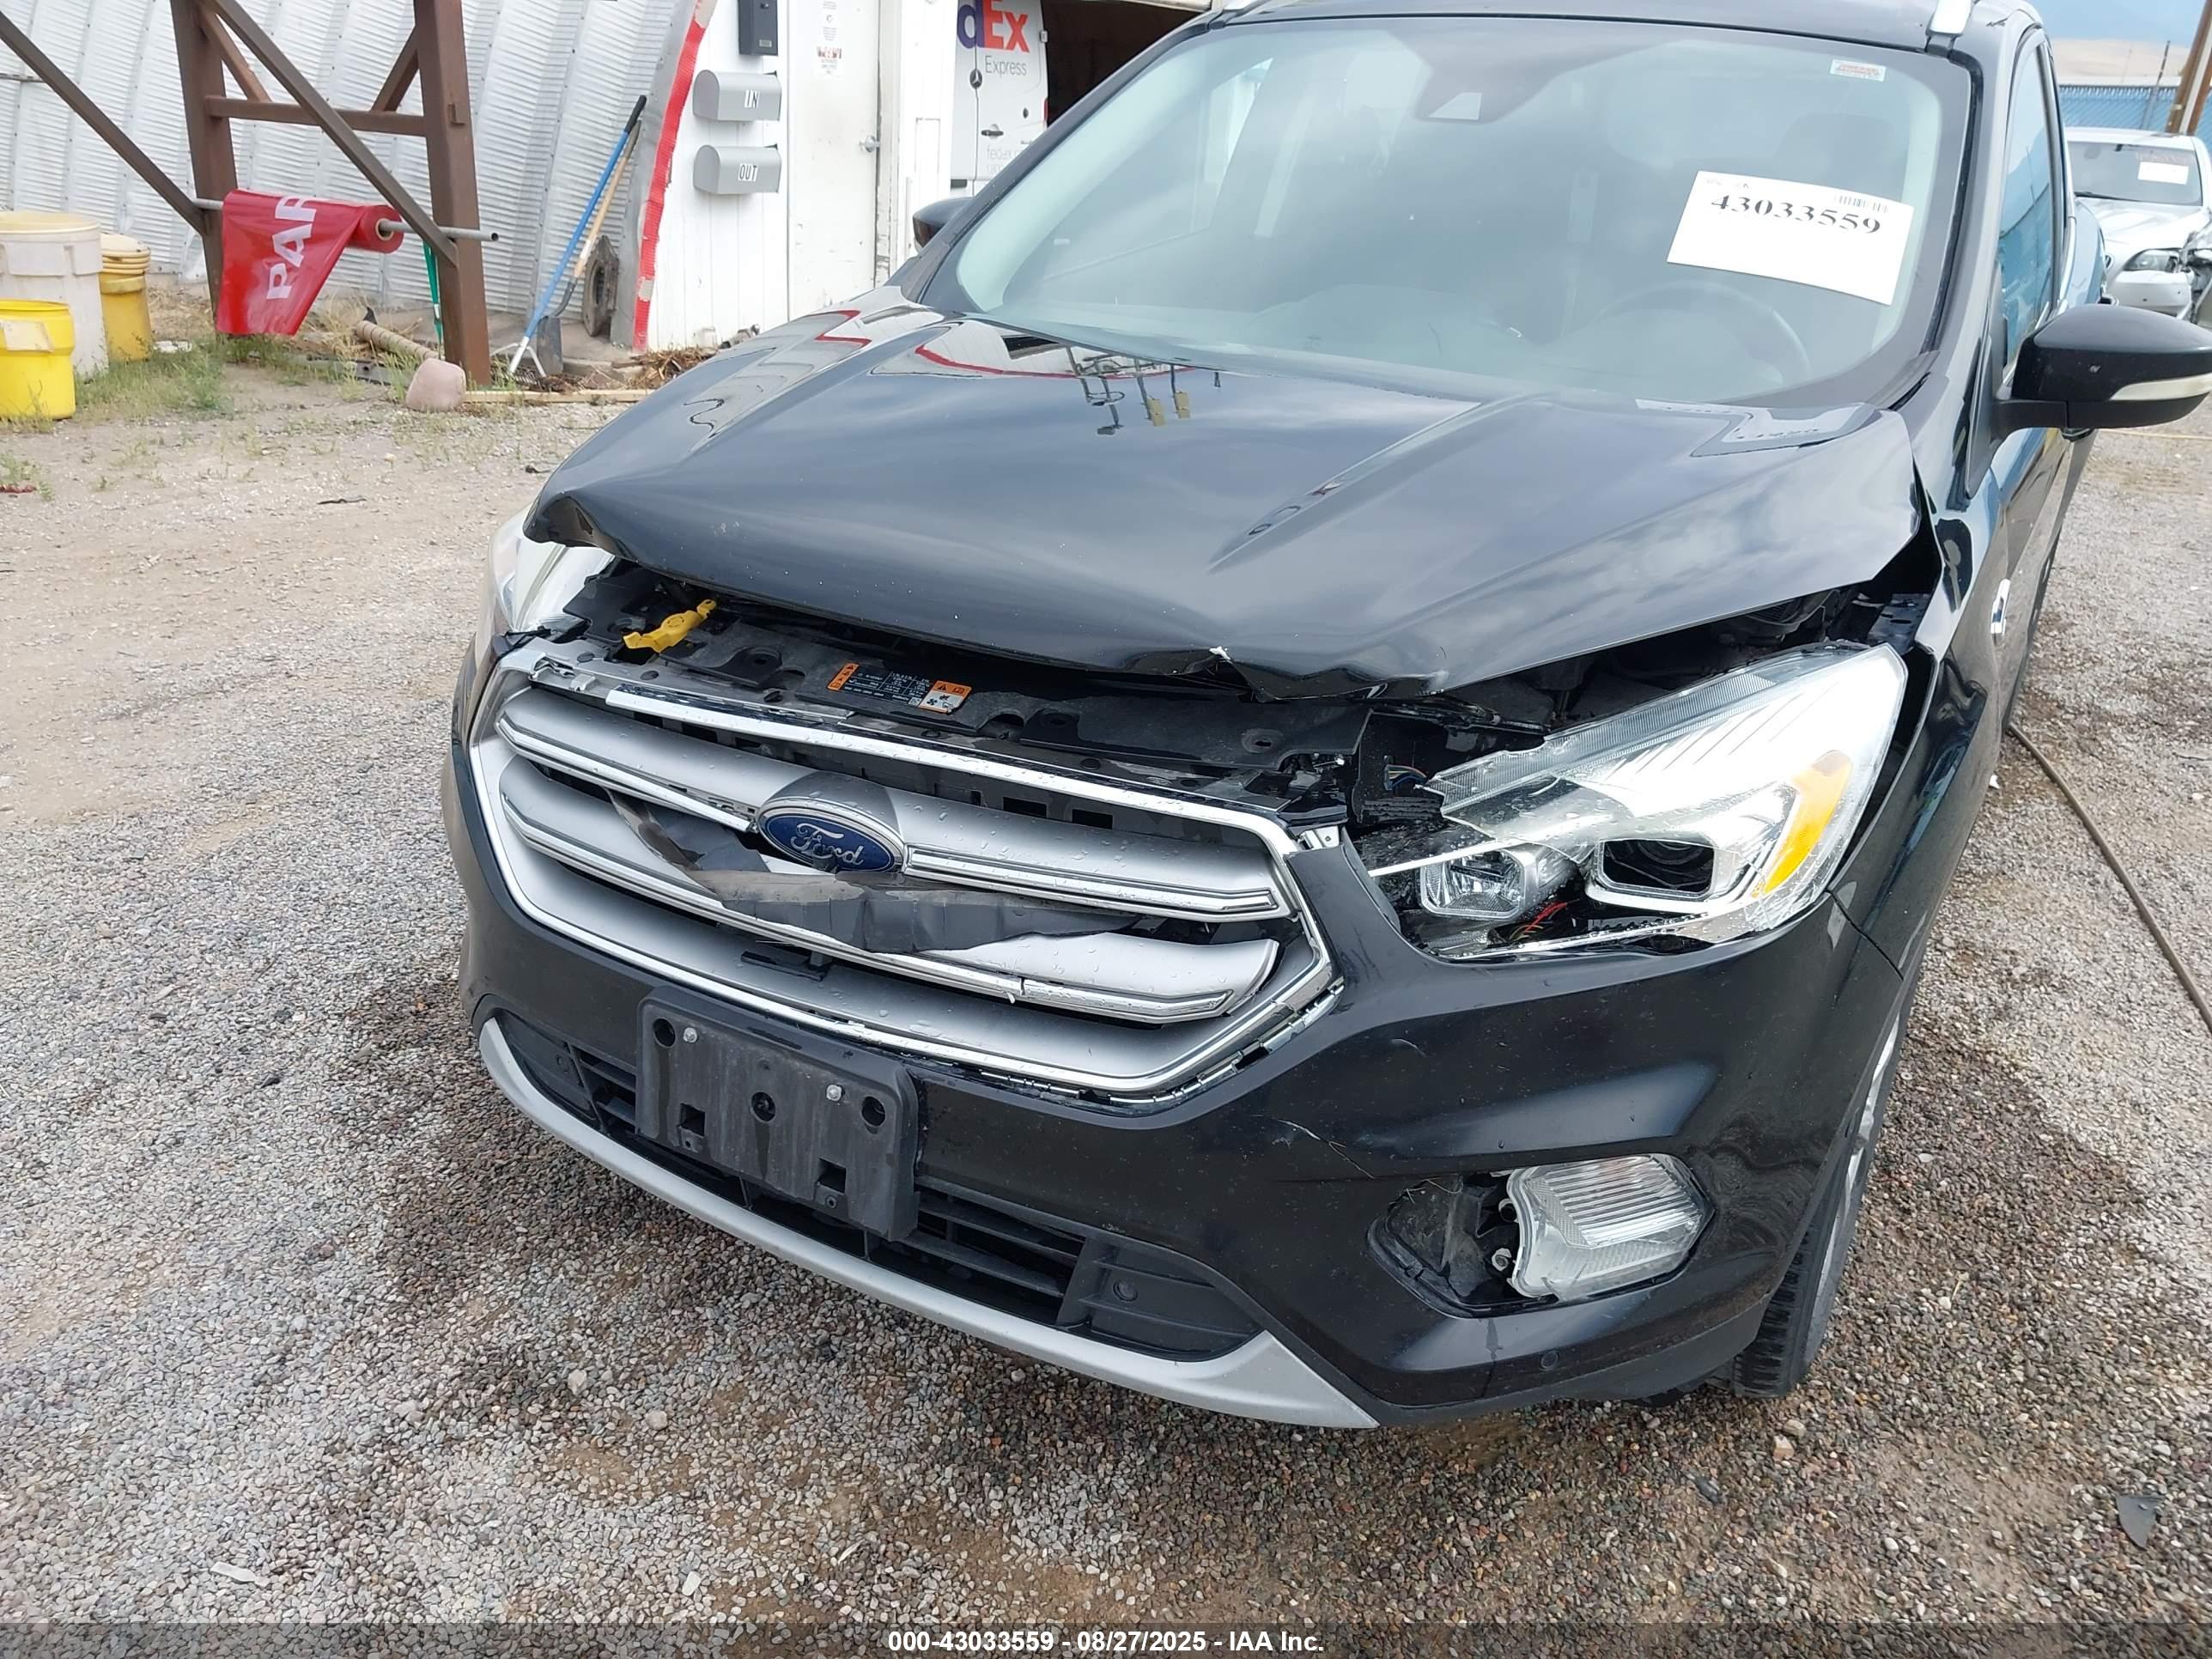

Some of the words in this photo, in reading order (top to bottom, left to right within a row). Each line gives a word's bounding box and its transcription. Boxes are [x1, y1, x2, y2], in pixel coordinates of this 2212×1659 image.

[985, 55, 1027, 77] Express
[747, 89, 758, 108] IN
[739, 164, 757, 180] OUT
[1711, 194, 1881, 234] 43033559
[790, 822, 866, 866] Ford
